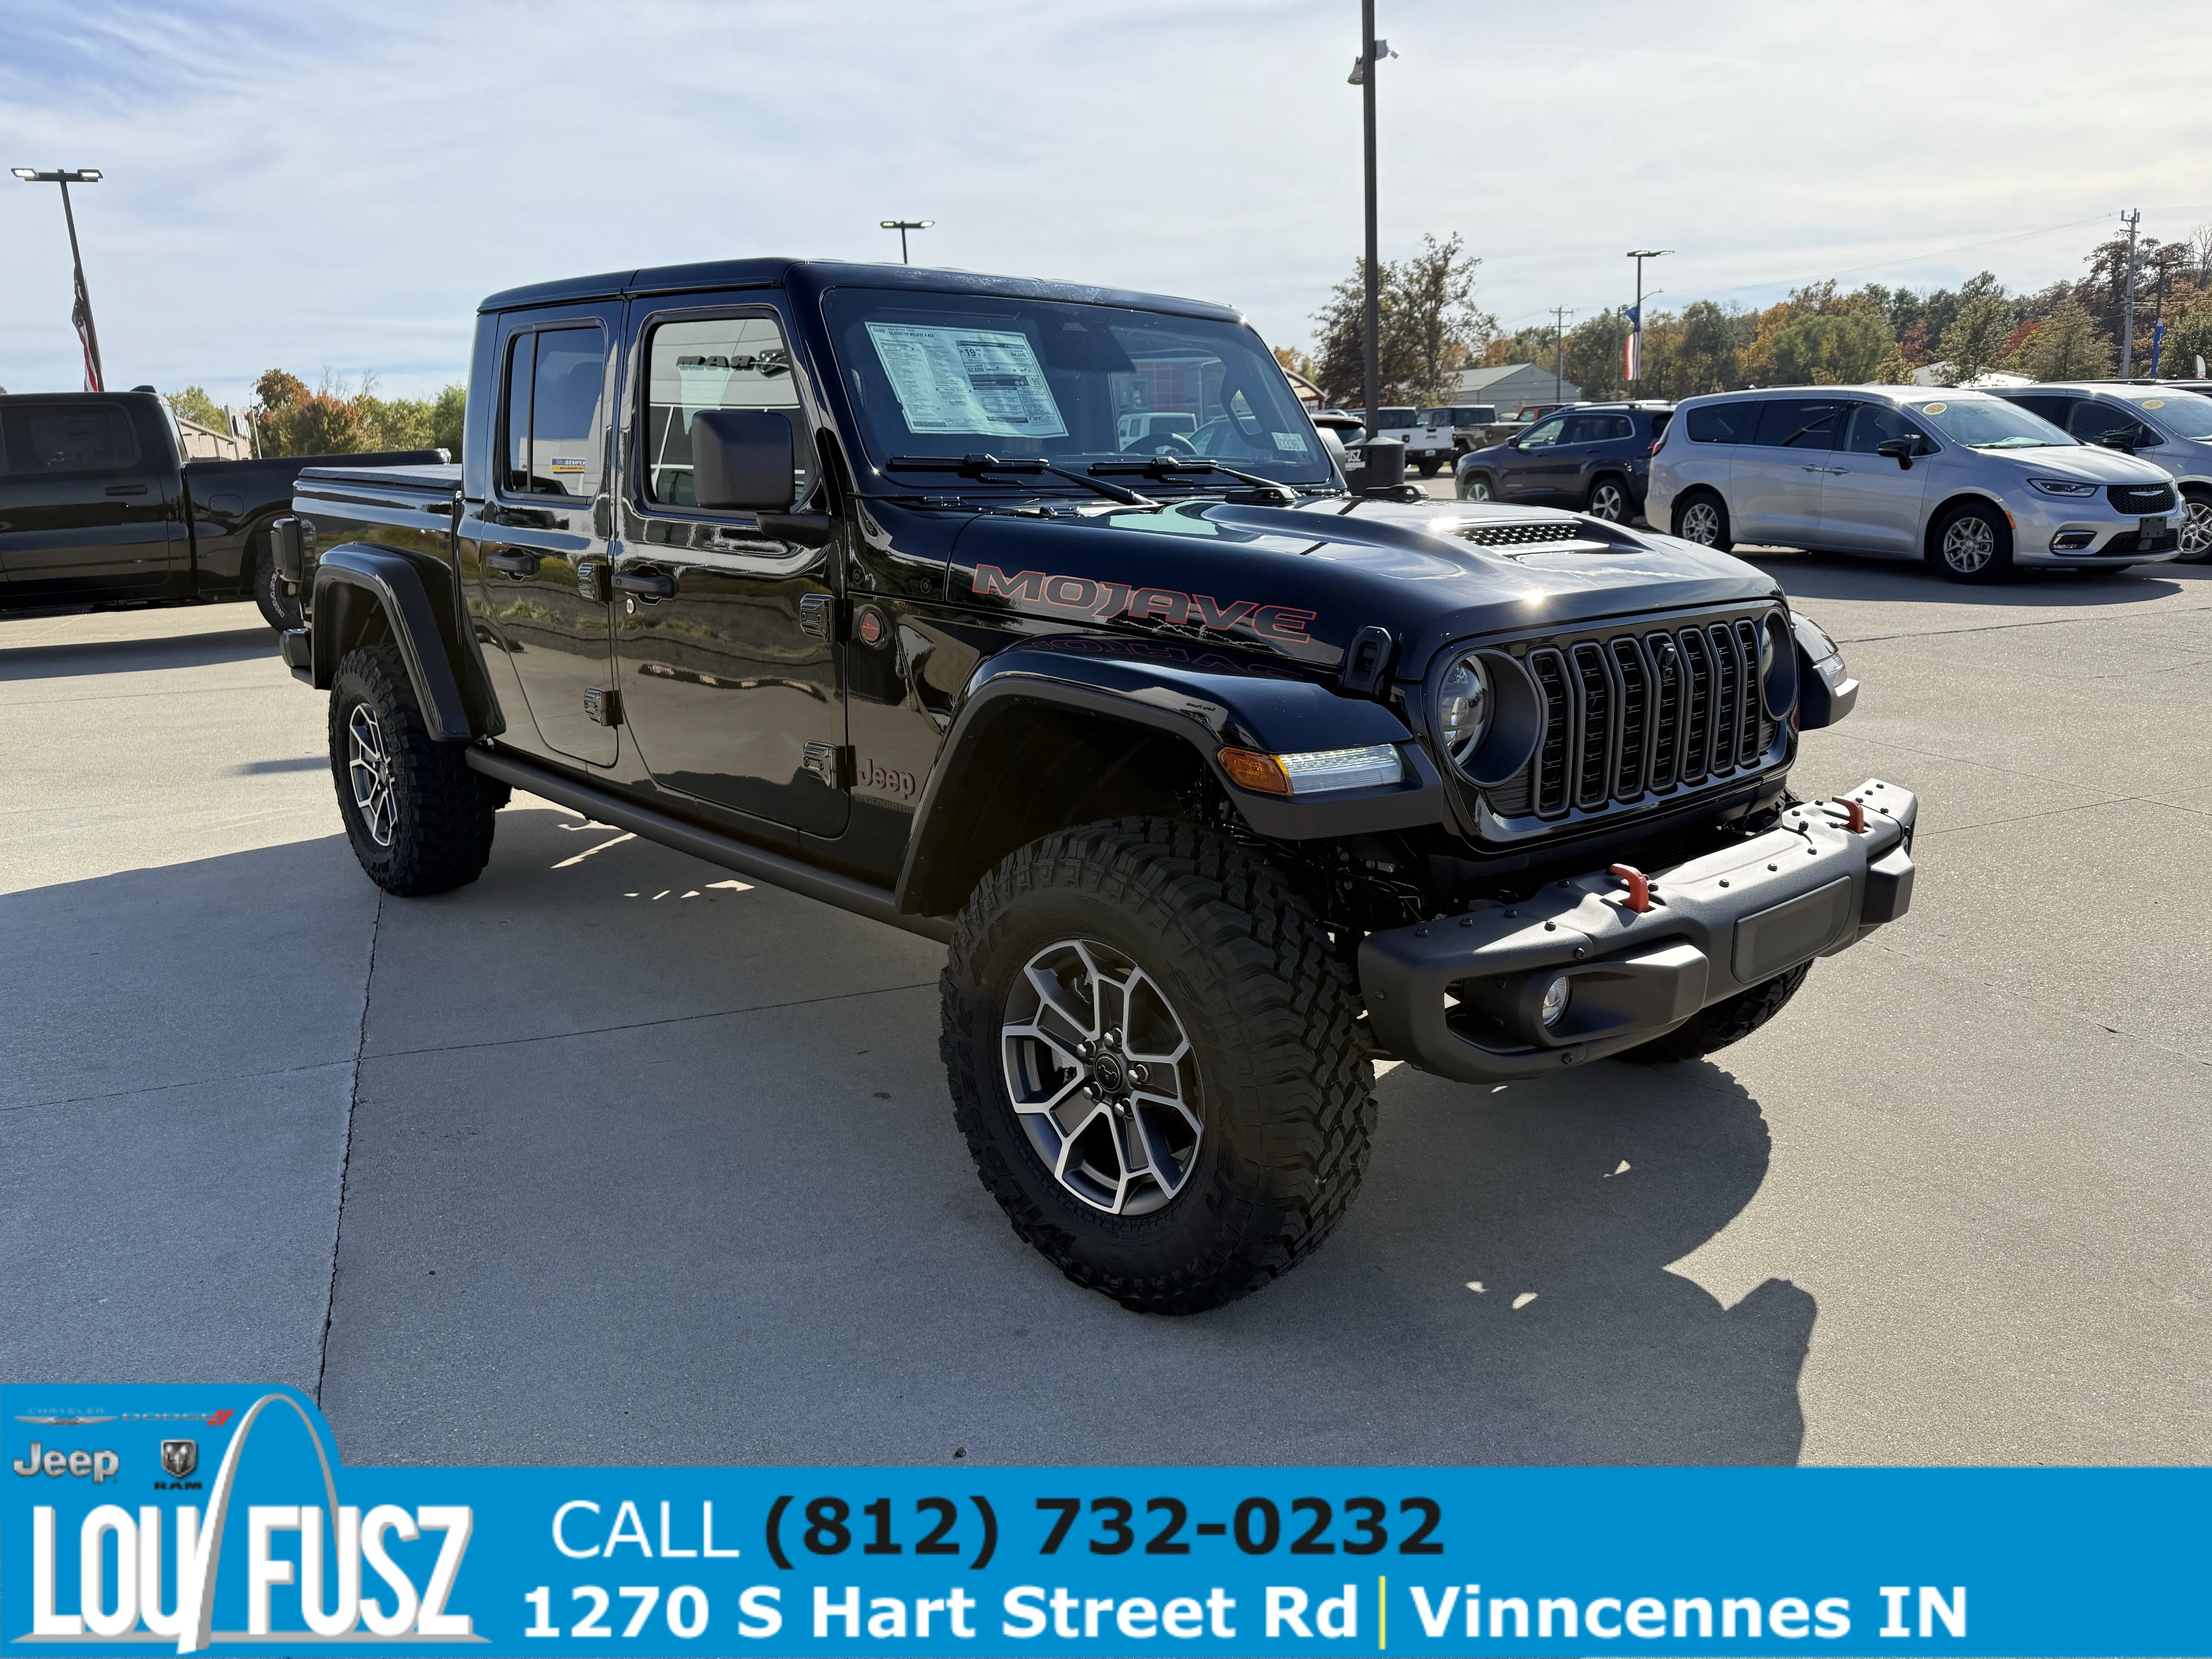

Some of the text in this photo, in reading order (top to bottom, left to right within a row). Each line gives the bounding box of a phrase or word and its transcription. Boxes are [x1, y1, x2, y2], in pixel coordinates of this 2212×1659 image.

[965, 349, 976, 357] 19
[972, 563, 1317, 643] MOJAVE
[858, 758, 915, 800] Jeep
